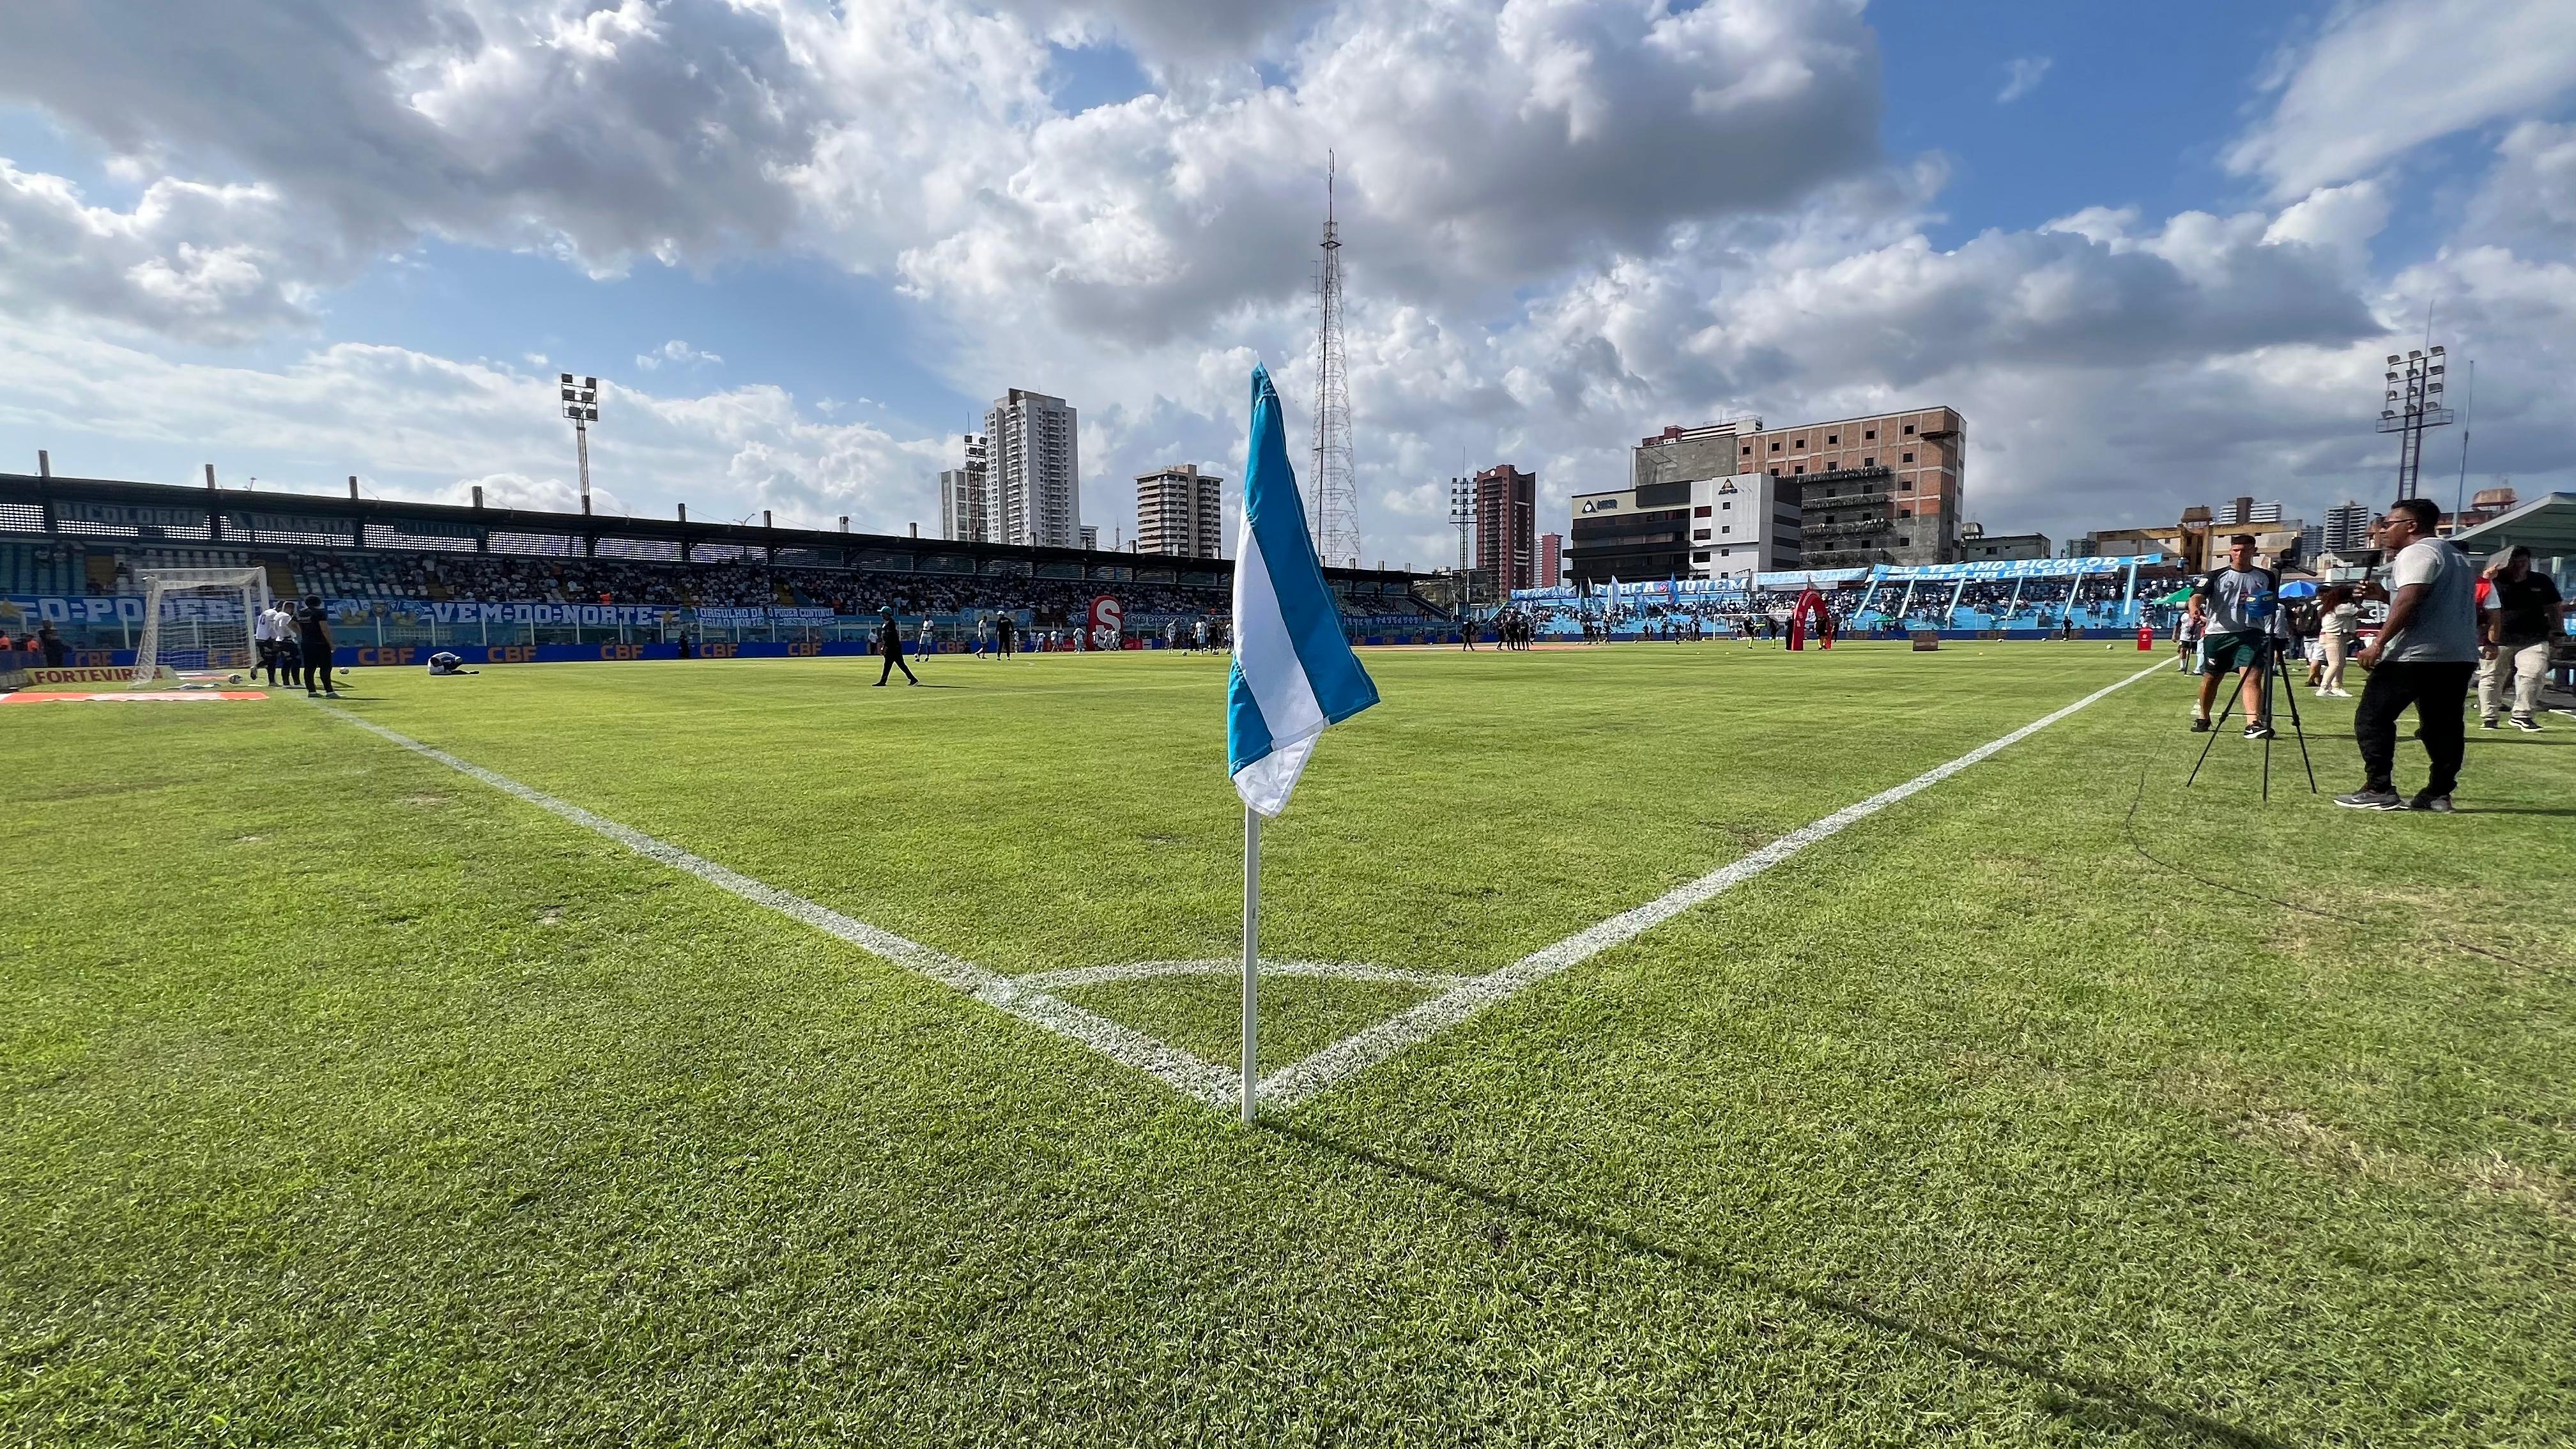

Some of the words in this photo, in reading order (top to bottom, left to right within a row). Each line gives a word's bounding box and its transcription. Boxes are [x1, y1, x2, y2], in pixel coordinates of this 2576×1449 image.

[1891, 565, 1919, 574] EU
[1928, 564, 1956, 574] TE
[2014, 556, 2120, 569] BICOLOR
[2004, 566, 2094, 577] CELESTE
[432, 602, 505, 623] VEM
[514, 604, 553, 624] DO
[561, 605, 652, 625] NORTE
[700, 608, 749, 618] ORGULHO
[751, 608, 764, 617] DA
[487, 645, 537, 663] CBF
[601, 644, 644, 660] CBF
[700, 643, 739, 657] CBF
[787, 643, 824, 656] CBF
[937, 641, 966, 653] CBF
[75, 651, 112, 666] CBF
[358, 647, 415, 666] CBF
